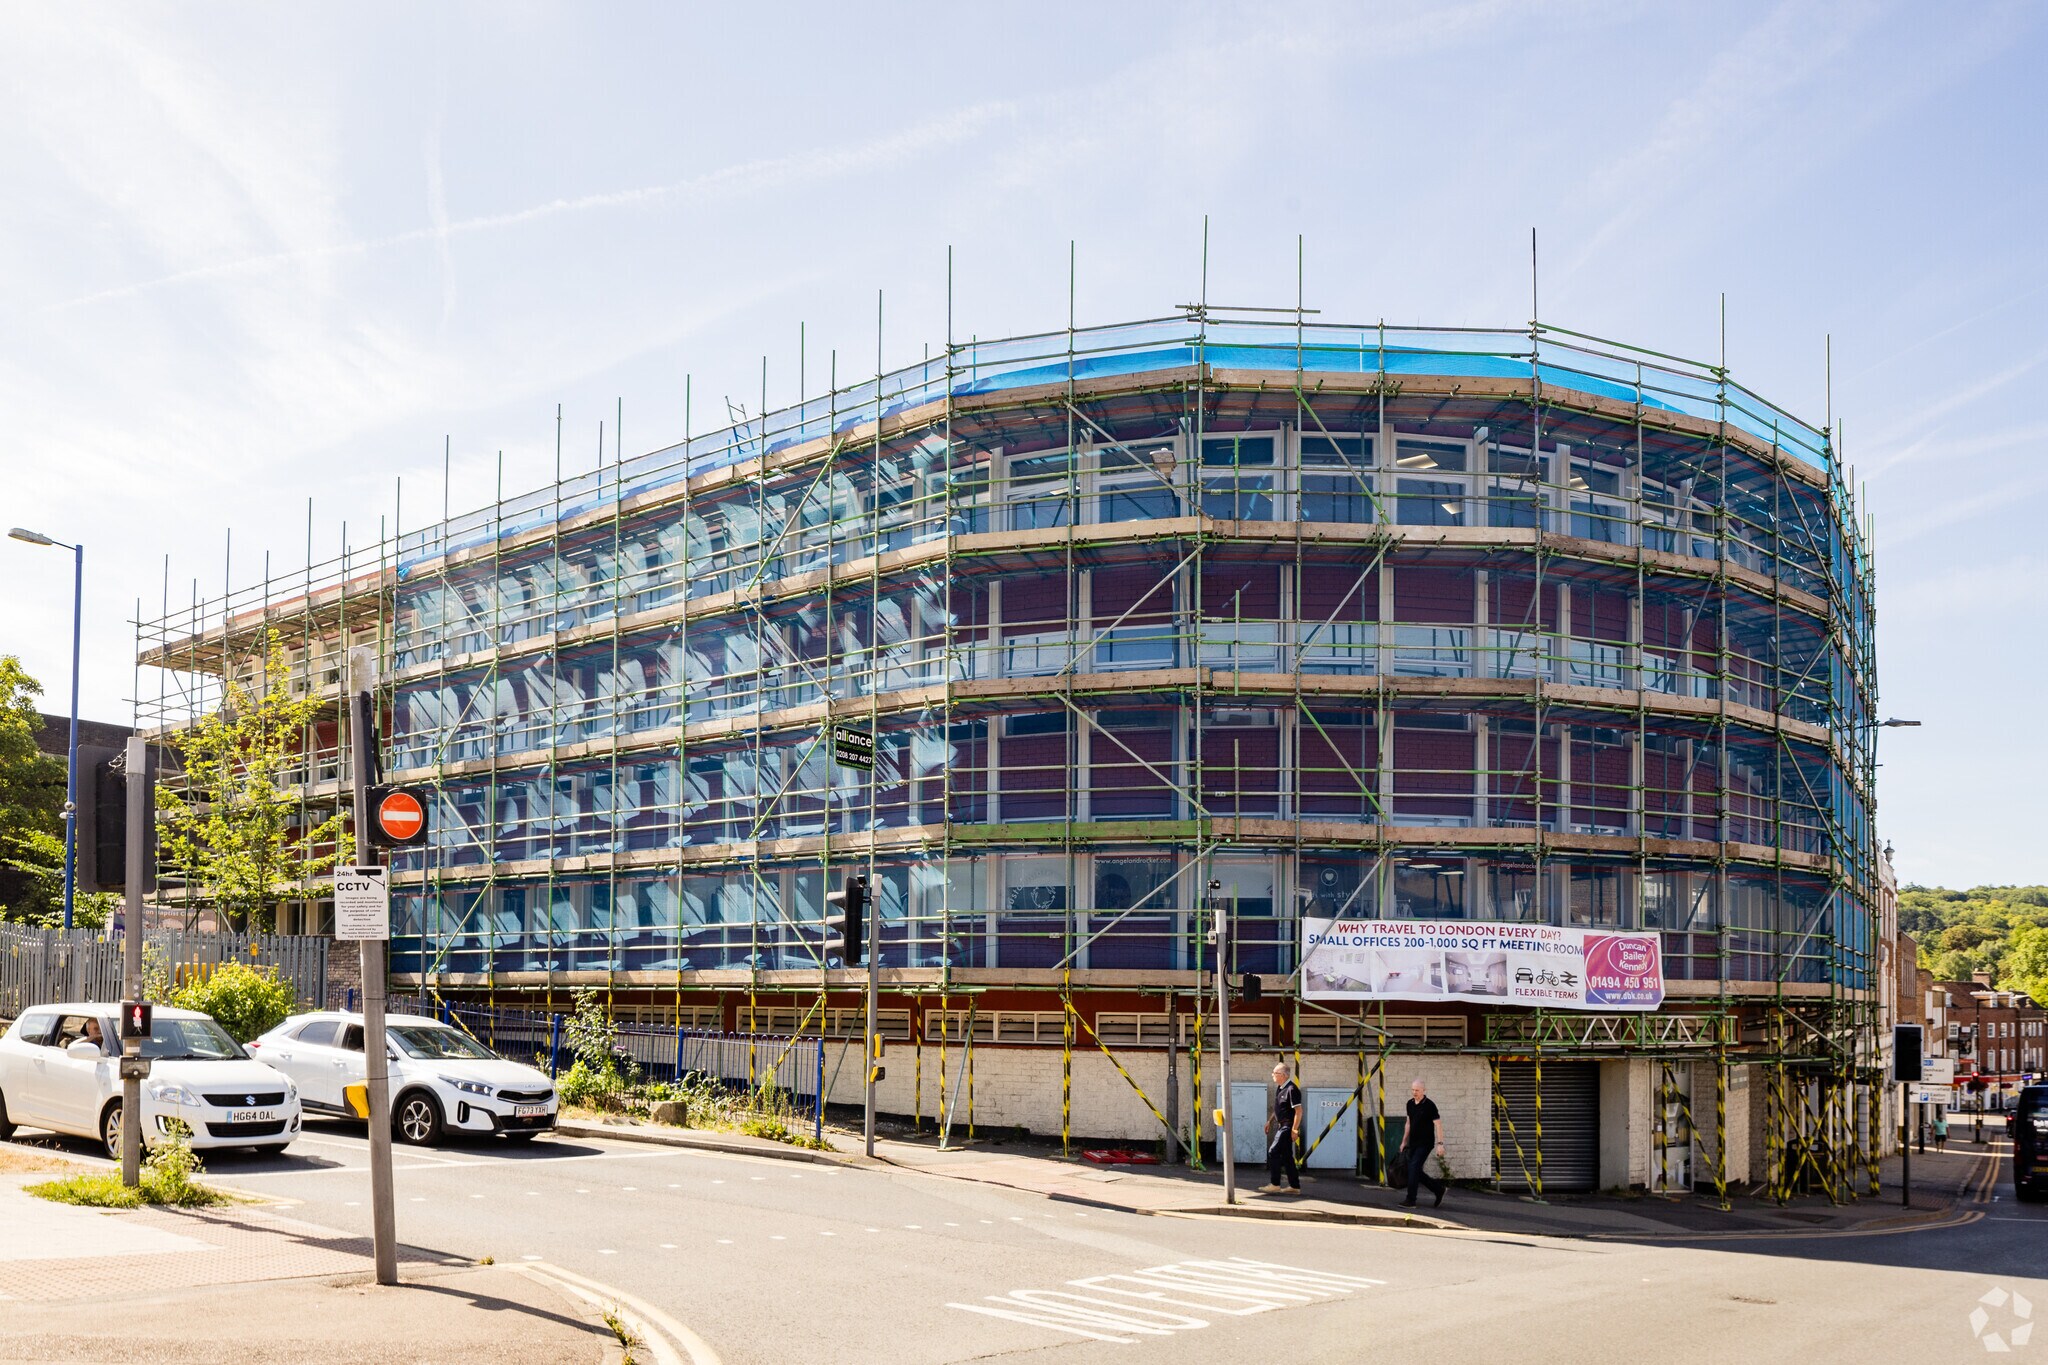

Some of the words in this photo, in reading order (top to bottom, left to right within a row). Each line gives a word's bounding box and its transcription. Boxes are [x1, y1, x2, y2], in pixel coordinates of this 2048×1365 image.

[836, 730, 872, 747] alliance
[836, 750, 848, 759] 0208
[849, 752, 858, 760] 207
[859, 755, 872, 764] 4427
[337, 882, 370, 891] CCTV
[1338, 924, 1368, 933] WHY
[1372, 924, 1416, 934] TRAVEL
[1419, 925, 1436, 935] TO
[1439, 925, 1495, 936] LONDON
[1499, 927, 1537, 938] EVERY
[1541, 929, 1561, 940] DAY?
[1308, 934, 1348, 946] SMALL
[1352, 936, 1400, 947] OFFICES
[1404, 937, 1458, 949] 200-1,000
[1462, 938, 1478, 950] SQ
[1482, 939, 1496, 949] FT
[1500, 941, 1551, 952] MEETING
[1554, 944, 1584, 956] ROOM
[1619, 942, 1646, 952] Duncan
[1623, 952, 1646, 962] Bailey
[1619, 960, 1648, 971] Kennedy
[1591, 976, 1620, 988] 01494
[1624, 977, 1640, 988] 450
[1642, 977, 1658, 988] 951
[1515, 988, 1552, 997] FLEXIBLE
[1554, 991, 1578, 999] TERMS
[1605, 992, 1653, 1000] www.dbk.co.uk
[233, 1111, 257, 1120] HG64
[259, 1111, 276, 1120] OAL
[1065, 1256, 1388, 1316] ENTRY
[945, 1288, 1210, 1344] NO
